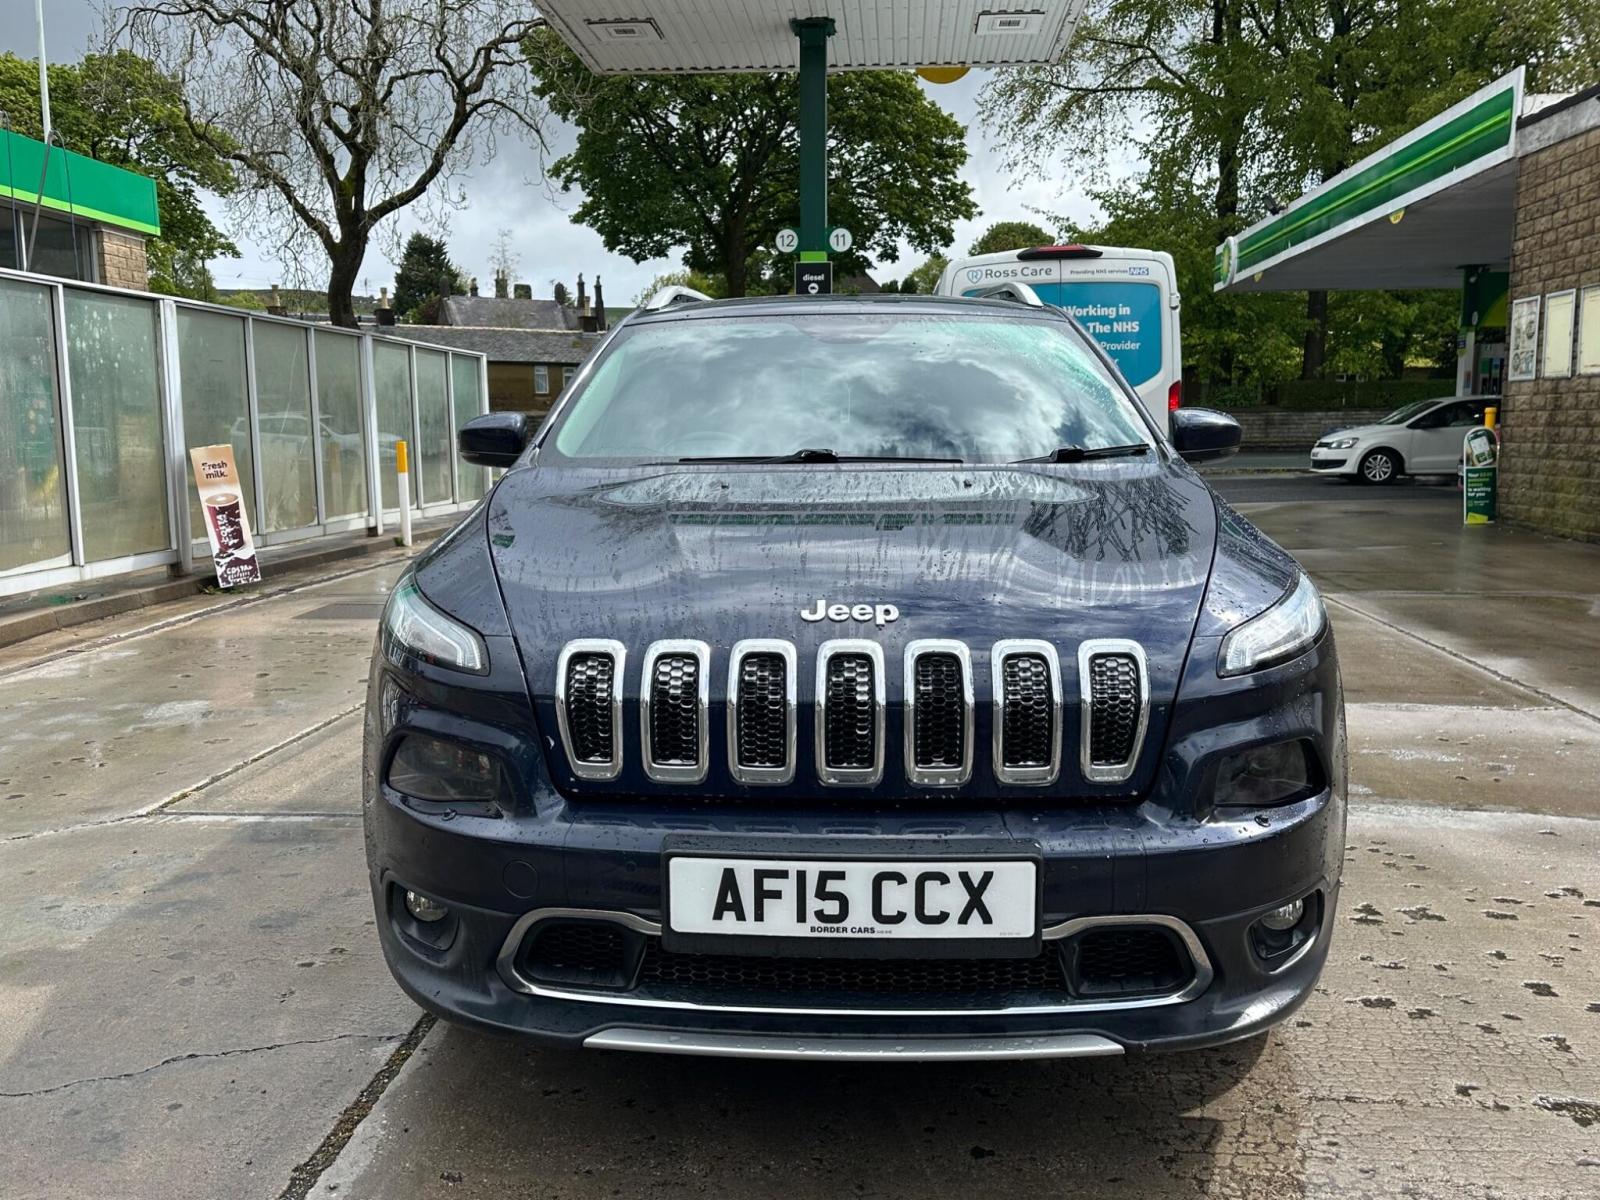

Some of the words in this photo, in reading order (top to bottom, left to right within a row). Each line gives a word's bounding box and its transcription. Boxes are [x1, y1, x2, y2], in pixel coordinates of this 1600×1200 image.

[780, 234, 795, 247] 12
[834, 234, 846, 247] 11
[802, 273, 825, 281] diesel
[985, 268, 1018, 279] Ross
[1020, 267, 1053, 277] Care
[1129, 267, 1149, 275] NHS
[1062, 304, 1117, 318] Working
[1119, 303, 1131, 315] in
[1087, 321, 1111, 333] The
[1113, 321, 1140, 333] NHS
[1100, 340, 1141, 350] Provider
[201, 460, 228, 471] Fresh
[800, 600, 900, 625] Jeep
[712, 867, 850, 925] AF15
[871, 870, 994, 926] CCX
[810, 926, 848, 934] BORDER
[850, 926, 876, 934] CARS
